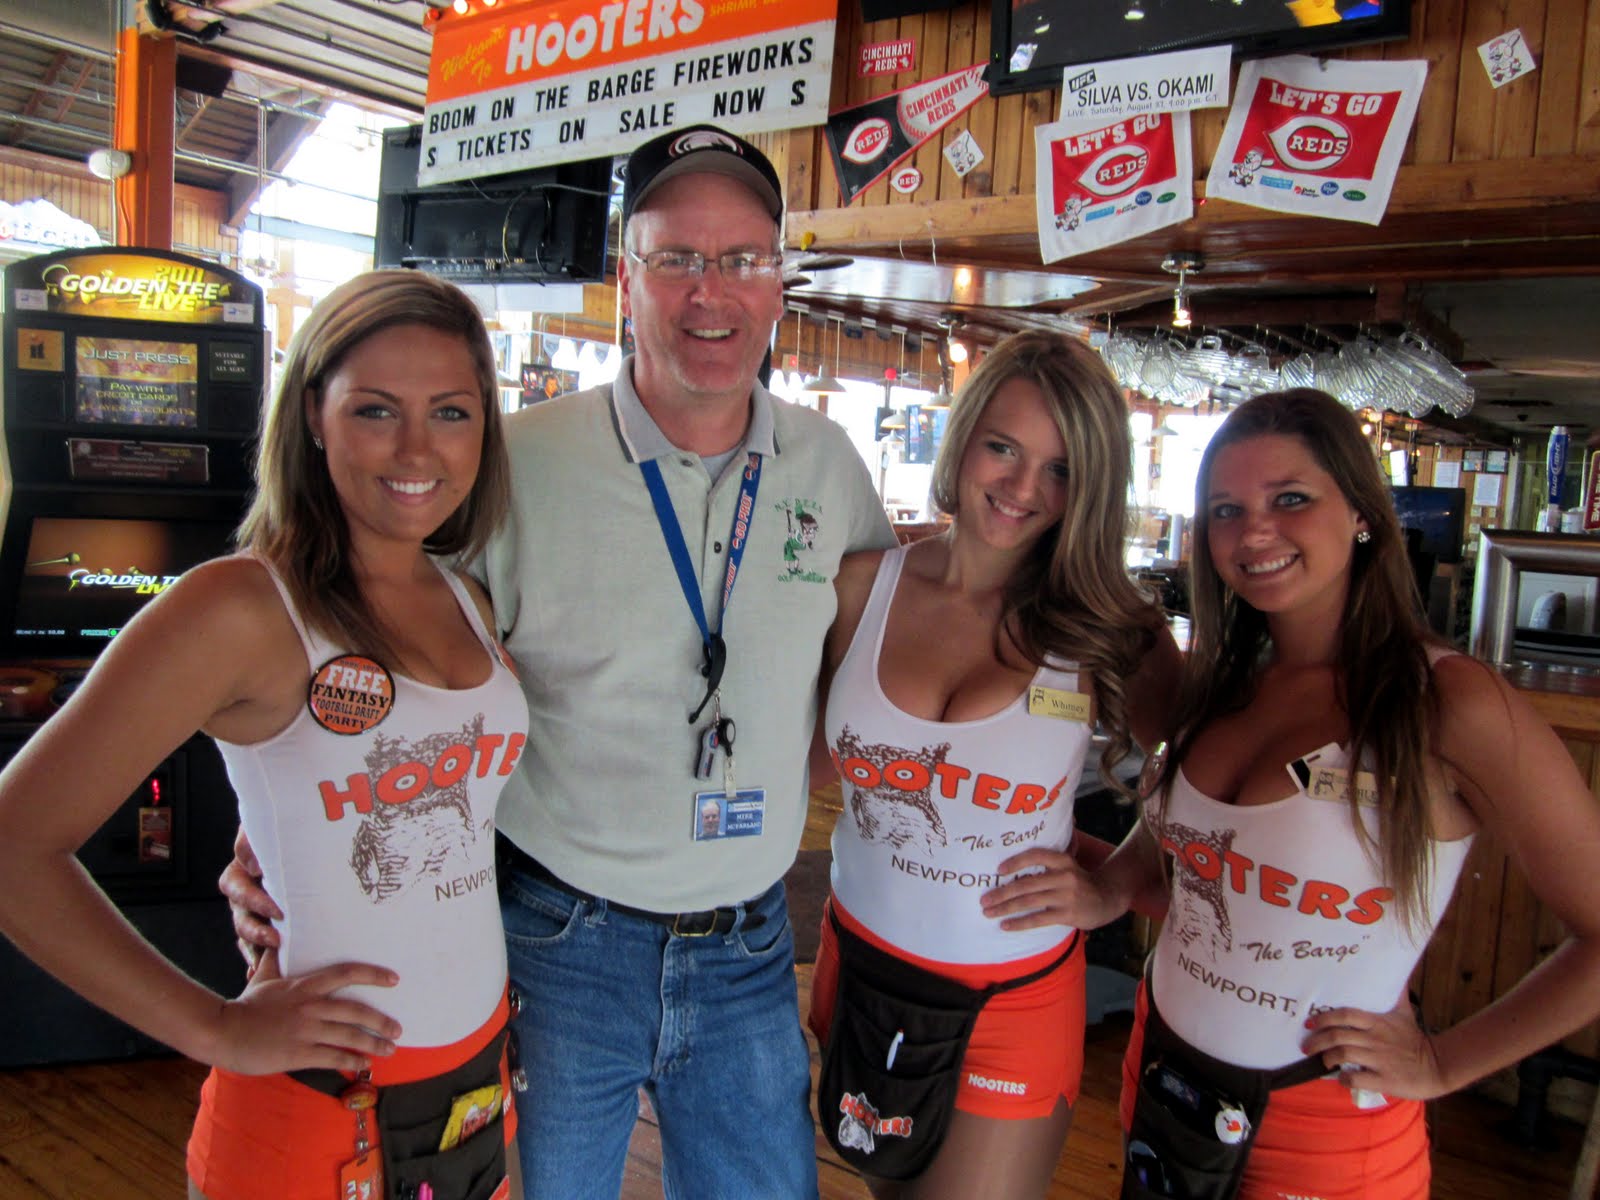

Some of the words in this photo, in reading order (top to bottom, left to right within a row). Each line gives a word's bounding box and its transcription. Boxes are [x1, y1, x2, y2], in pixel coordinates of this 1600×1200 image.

[505, 0, 705, 75] HOOTERS
[862, 42, 912, 60] CINCINNATI
[472, 57, 492, 86] To
[875, 58, 898, 72] REDS
[429, 105, 477, 135] BOOM
[491, 97, 516, 122] ON
[535, 86, 569, 112] THE
[587, 67, 656, 102] BARGE
[674, 37, 813, 87] FIREWORKS
[1071, 72, 1097, 91] UFC
[1077, 85, 1122, 108] SILVA
[1127, 81, 1152, 102] VS.
[1157, 73, 1214, 98] OKAMI
[905, 74, 969, 119] CINCINNATI
[1269, 82, 1340, 115] LET'S
[1345, 94, 1382, 116] GO
[457, 129, 532, 162] TICKETS
[559, 119, 586, 143] ON
[619, 102, 675, 134] SALE
[713, 86, 765, 118] NOW
[927, 98, 957, 125] REDS
[855, 126, 889, 152] REDS
[1063, 123, 1127, 157] LET'S
[1132, 112, 1160, 136] GO
[1289, 135, 1348, 155] REDS
[899, 175, 920, 186] REDS
[1099, 155, 1148, 182] REDS
[61, 274, 169, 296] GOLDEN
[173, 280, 220, 300] TEE
[155, 265, 206, 284] 2011
[137, 291, 199, 313] LIVE
[83, 347, 130, 361] JUST
[134, 350, 191, 365] PRESS
[81, 574, 151, 586] GOLDEN
[325, 664, 386, 694] FREE
[312, 684, 389, 708] FANTASY
[316, 698, 353, 715] FOOTBALL
[354, 705, 380, 720] DRAFT
[1051, 697, 1086, 713] Whitney
[324, 714, 367, 730] PARTY
[831, 747, 1068, 815] OOTERS
[967, 1073, 1026, 1095] HOOTERS
[840, 1092, 914, 1139] HOOTERS
